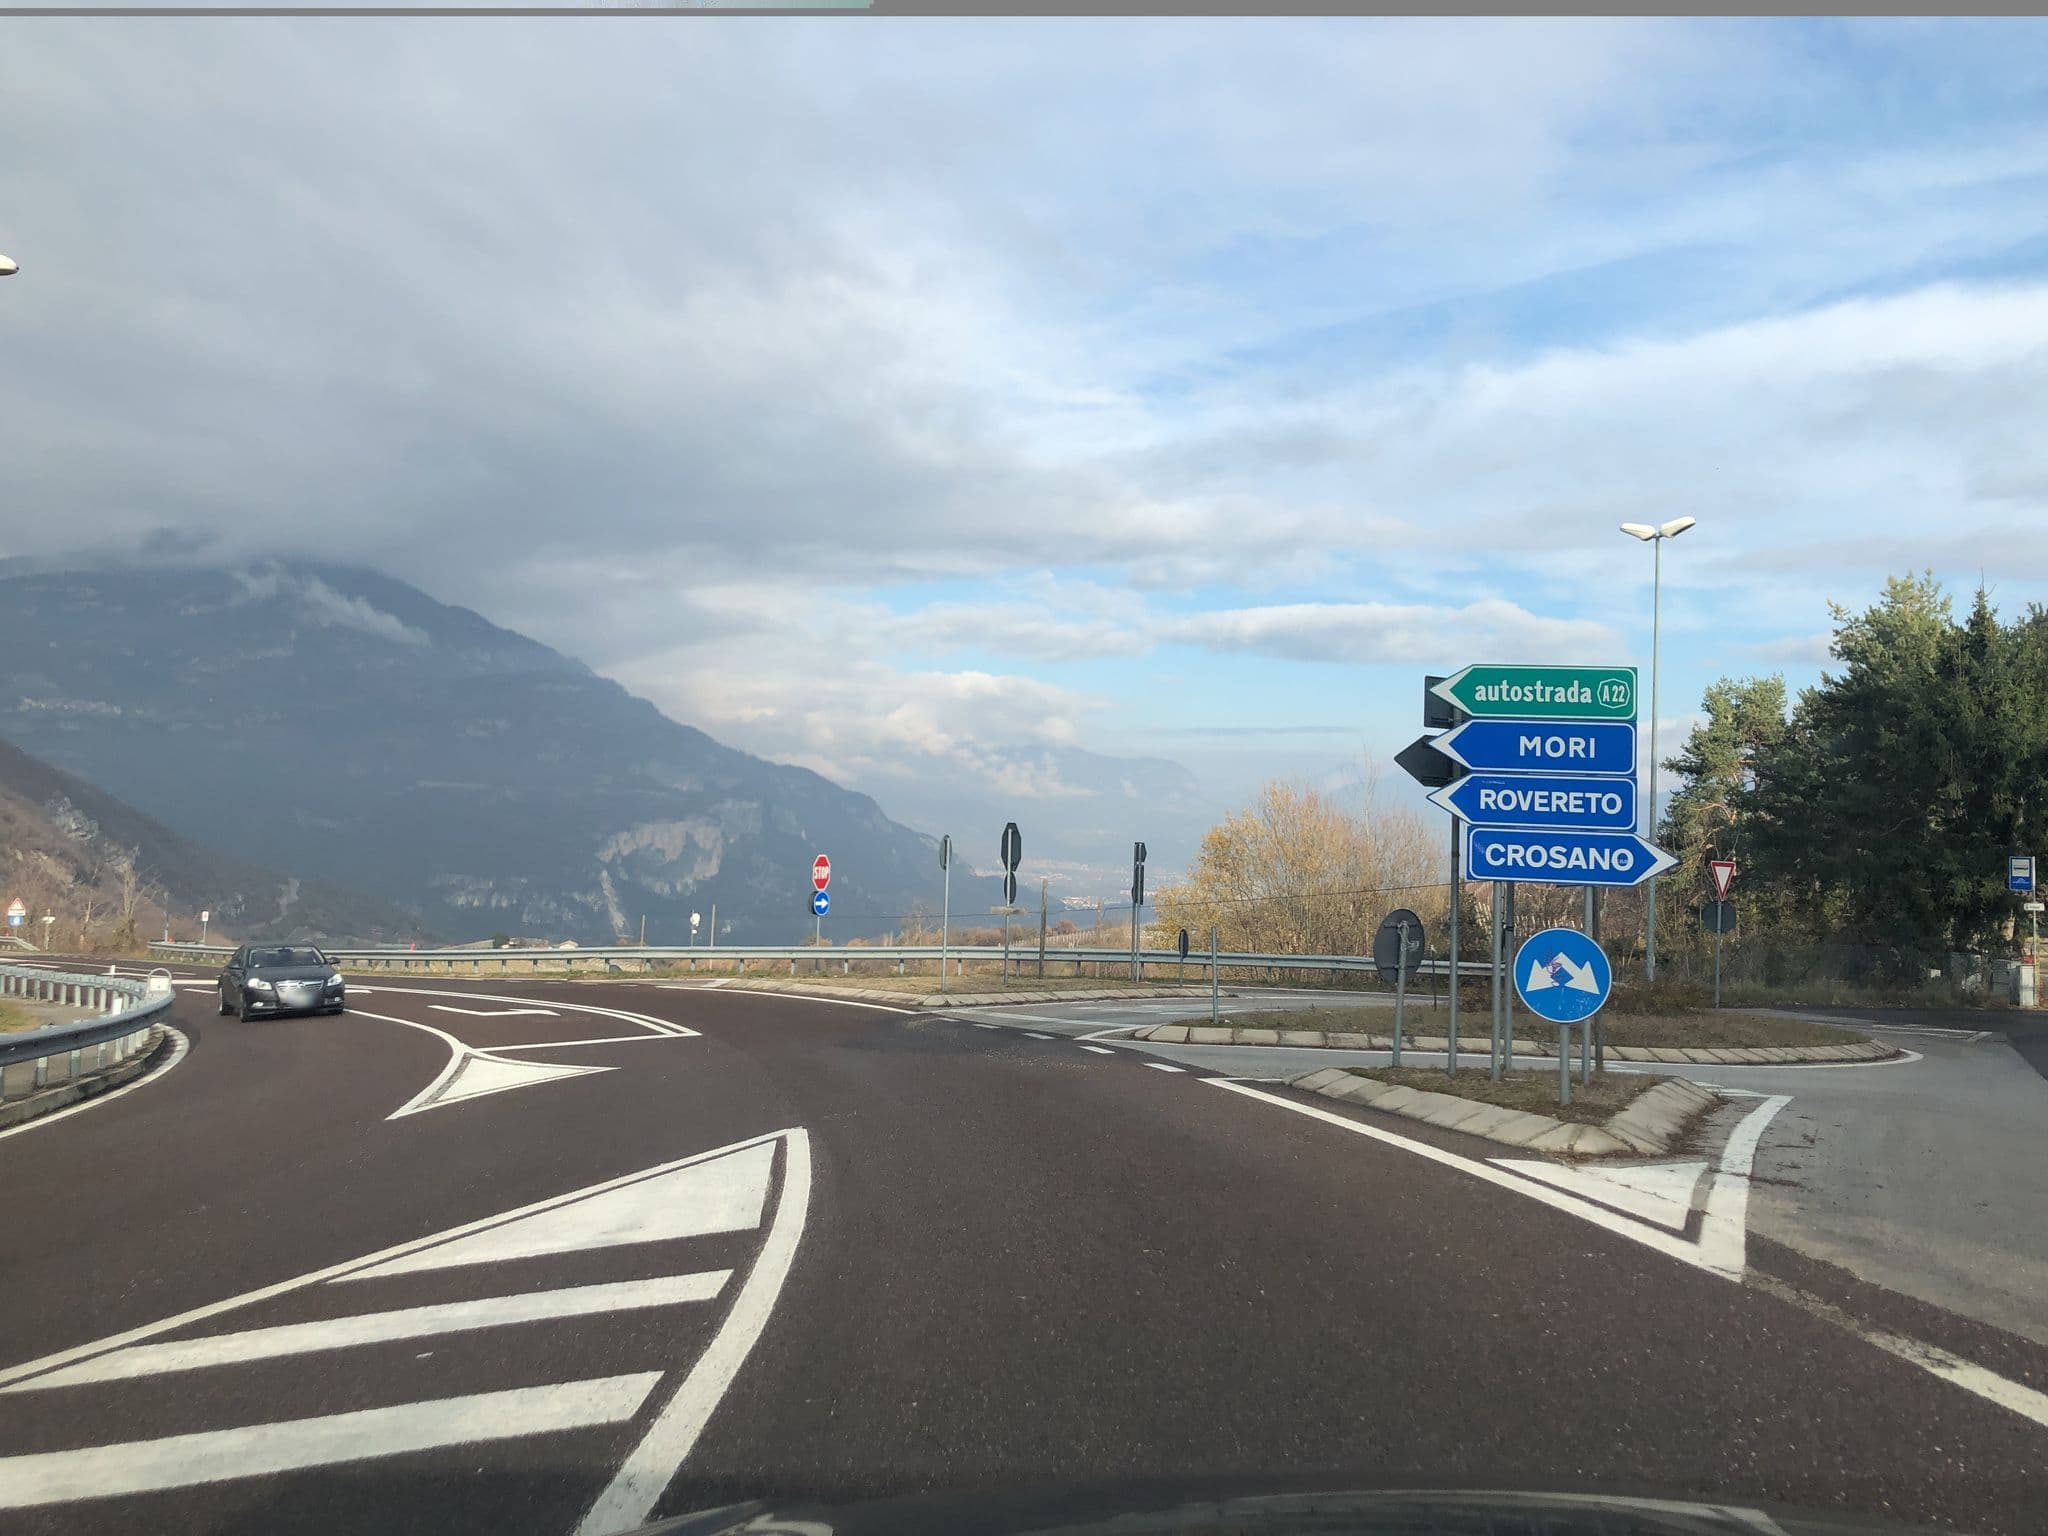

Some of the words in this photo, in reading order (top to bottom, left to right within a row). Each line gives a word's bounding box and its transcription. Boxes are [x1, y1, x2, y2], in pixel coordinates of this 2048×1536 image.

[1475, 680, 1592, 703] autostrada
[1519, 735, 1596, 759] MORI
[1479, 789, 1622, 815] ROVERETO
[1485, 843, 1634, 871] CROSANO
[814, 866, 829, 880] STOP
